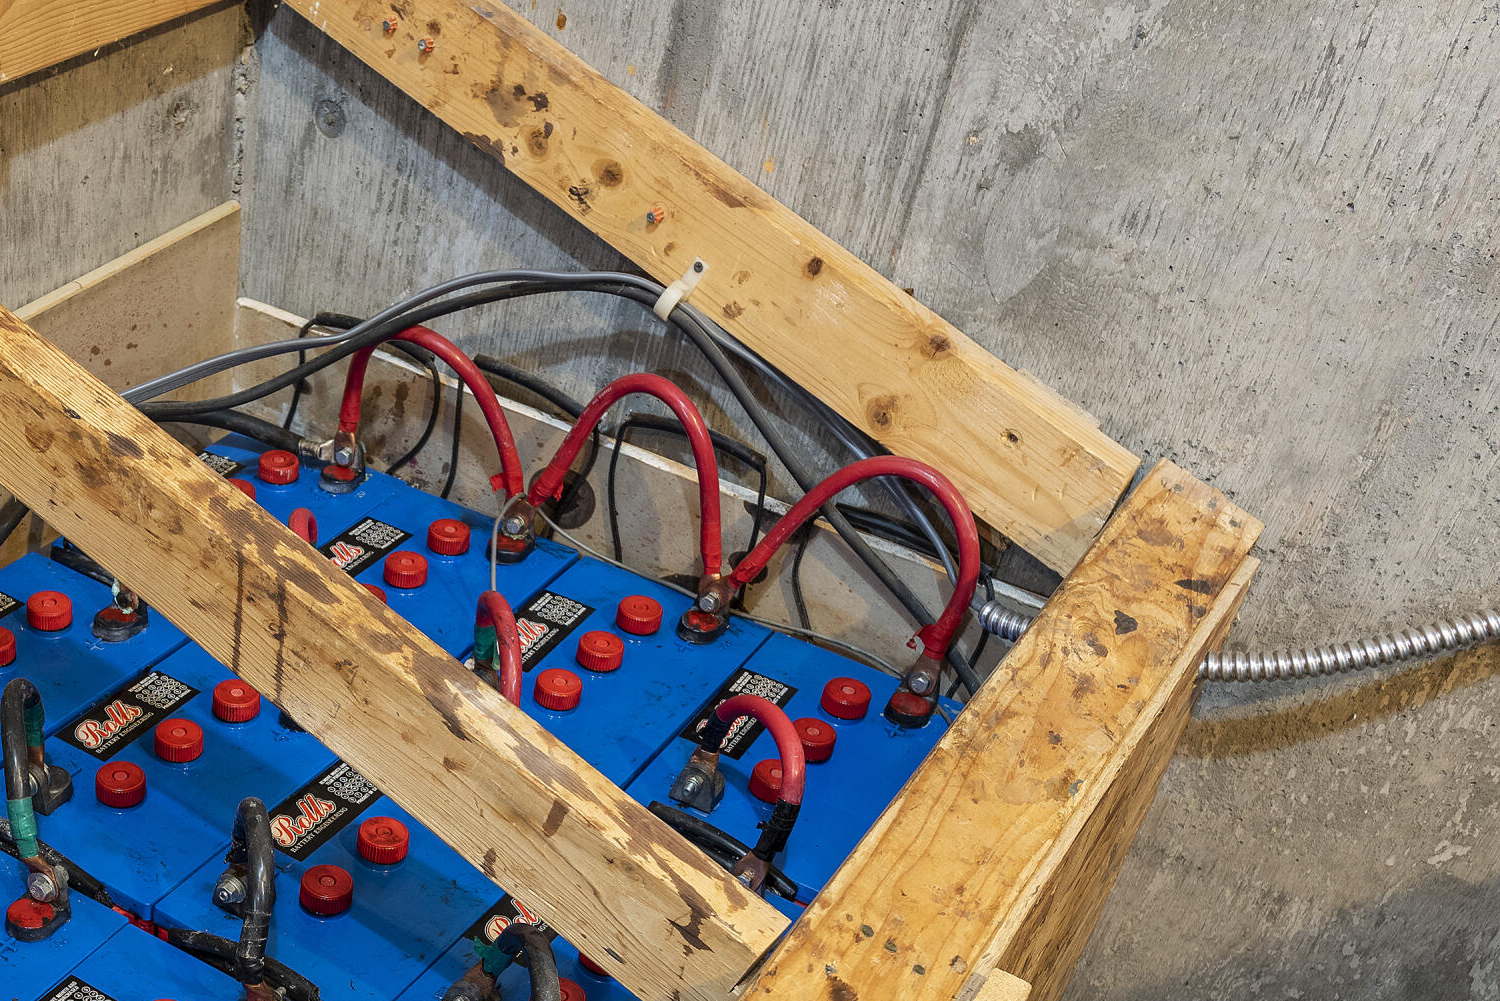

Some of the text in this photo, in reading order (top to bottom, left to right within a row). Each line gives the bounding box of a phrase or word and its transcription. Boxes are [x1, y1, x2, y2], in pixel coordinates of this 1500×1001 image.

[330, 541, 364, 568] olls
[516, 618, 549, 653] olls
[75, 700, 143, 748] Rolls
[269, 793, 336, 846] Rolls
[291, 833, 315, 852] BATTERY
